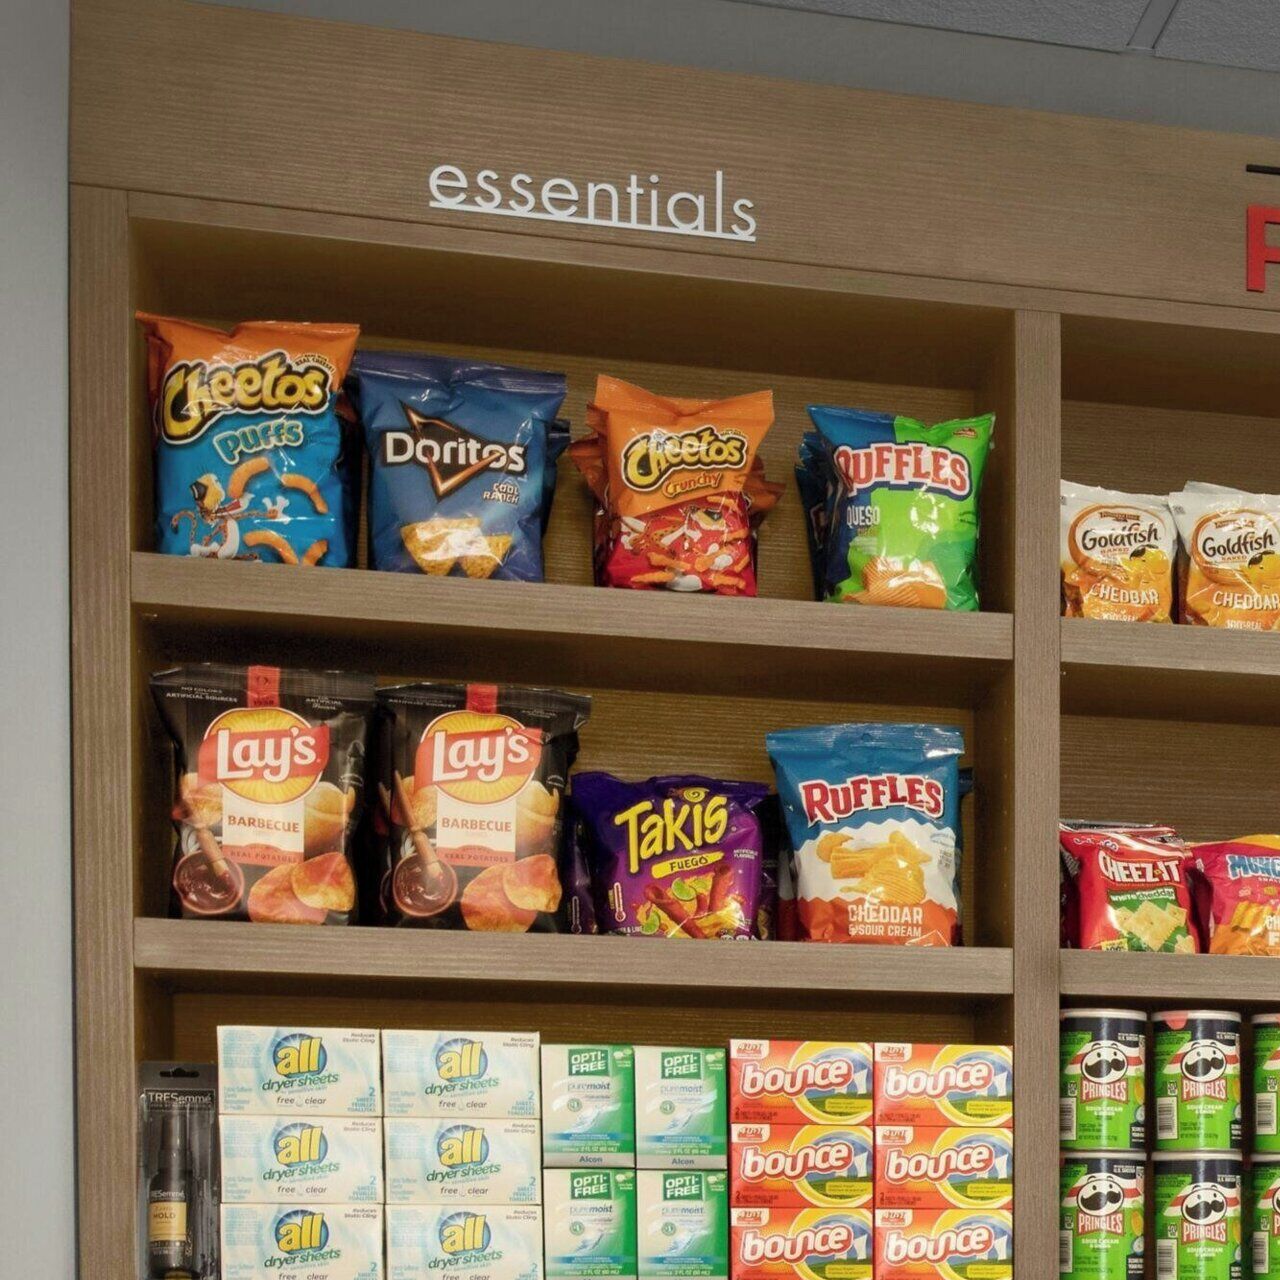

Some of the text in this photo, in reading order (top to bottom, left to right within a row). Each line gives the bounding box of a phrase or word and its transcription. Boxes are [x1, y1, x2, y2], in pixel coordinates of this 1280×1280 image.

[429, 165, 757, 241] essentials
[161, 350, 330, 440] Cheetos
[214, 420, 304, 464] PUFFS
[386, 430, 526, 473] Doritos
[624, 430, 746, 488] Cheetos
[483, 490, 521, 504] RANCH
[493, 482, 520, 496] COOL
[661, 471, 722, 498] Crunchy
[846, 504, 880, 526] QUESO
[1082, 523, 1160, 551] Goldfish
[1202, 531, 1277, 558] Goldfish
[1090, 583, 1160, 605] CHEDDAR
[216, 726, 316, 784] Lay's
[432, 727, 530, 783] Lay's
[800, 773, 945, 827] RUFFLES
[227, 815, 300, 833] BARBECUE
[441, 817, 513, 833] BARBECUE
[614, 797, 728, 874] Takis
[668, 856, 708, 872] FUEGO
[1098, 850, 1181, 883] CHEEZ-IT
[848, 904, 923, 926] CHEDDAR
[859, 925, 922, 938] SOUR CREAM
[278, 1036, 323, 1078] all
[437, 1038, 484, 1081] all
[571, 1052, 606, 1064] OPTI-
[571, 1061, 606, 1074] FREE
[262, 1072, 339, 1093] dryer sheets
[425, 1076, 499, 1096] dryer sheets
[741, 1059, 853, 1098] bounce
[885, 1063, 993, 1100] bounce
[1081, 1079, 1127, 1102] PRINGLES
[1182, 1079, 1228, 1102] PRINGLES
[277, 1096, 327, 1106] free clear
[277, 1126, 323, 1167] all
[439, 1127, 485, 1167] all
[579, 1155, 603, 1164] Alcon
[742, 1142, 853, 1182] bounce
[886, 1143, 995, 1184] bounce
[574, 1175, 608, 1187] OPTI-
[574, 1184, 609, 1197] FREE
[666, 1176, 701, 1188] OPTI-
[666, 1185, 702, 1198] FREE
[278, 1213, 325, 1253] all
[439, 1213, 487, 1253] all
[1077, 1212, 1124, 1235] PRINGLES
[1181, 1222, 1228, 1244] PRINGLES
[742, 1226, 853, 1266] bounce
[886, 1227, 995, 1267] bounce
